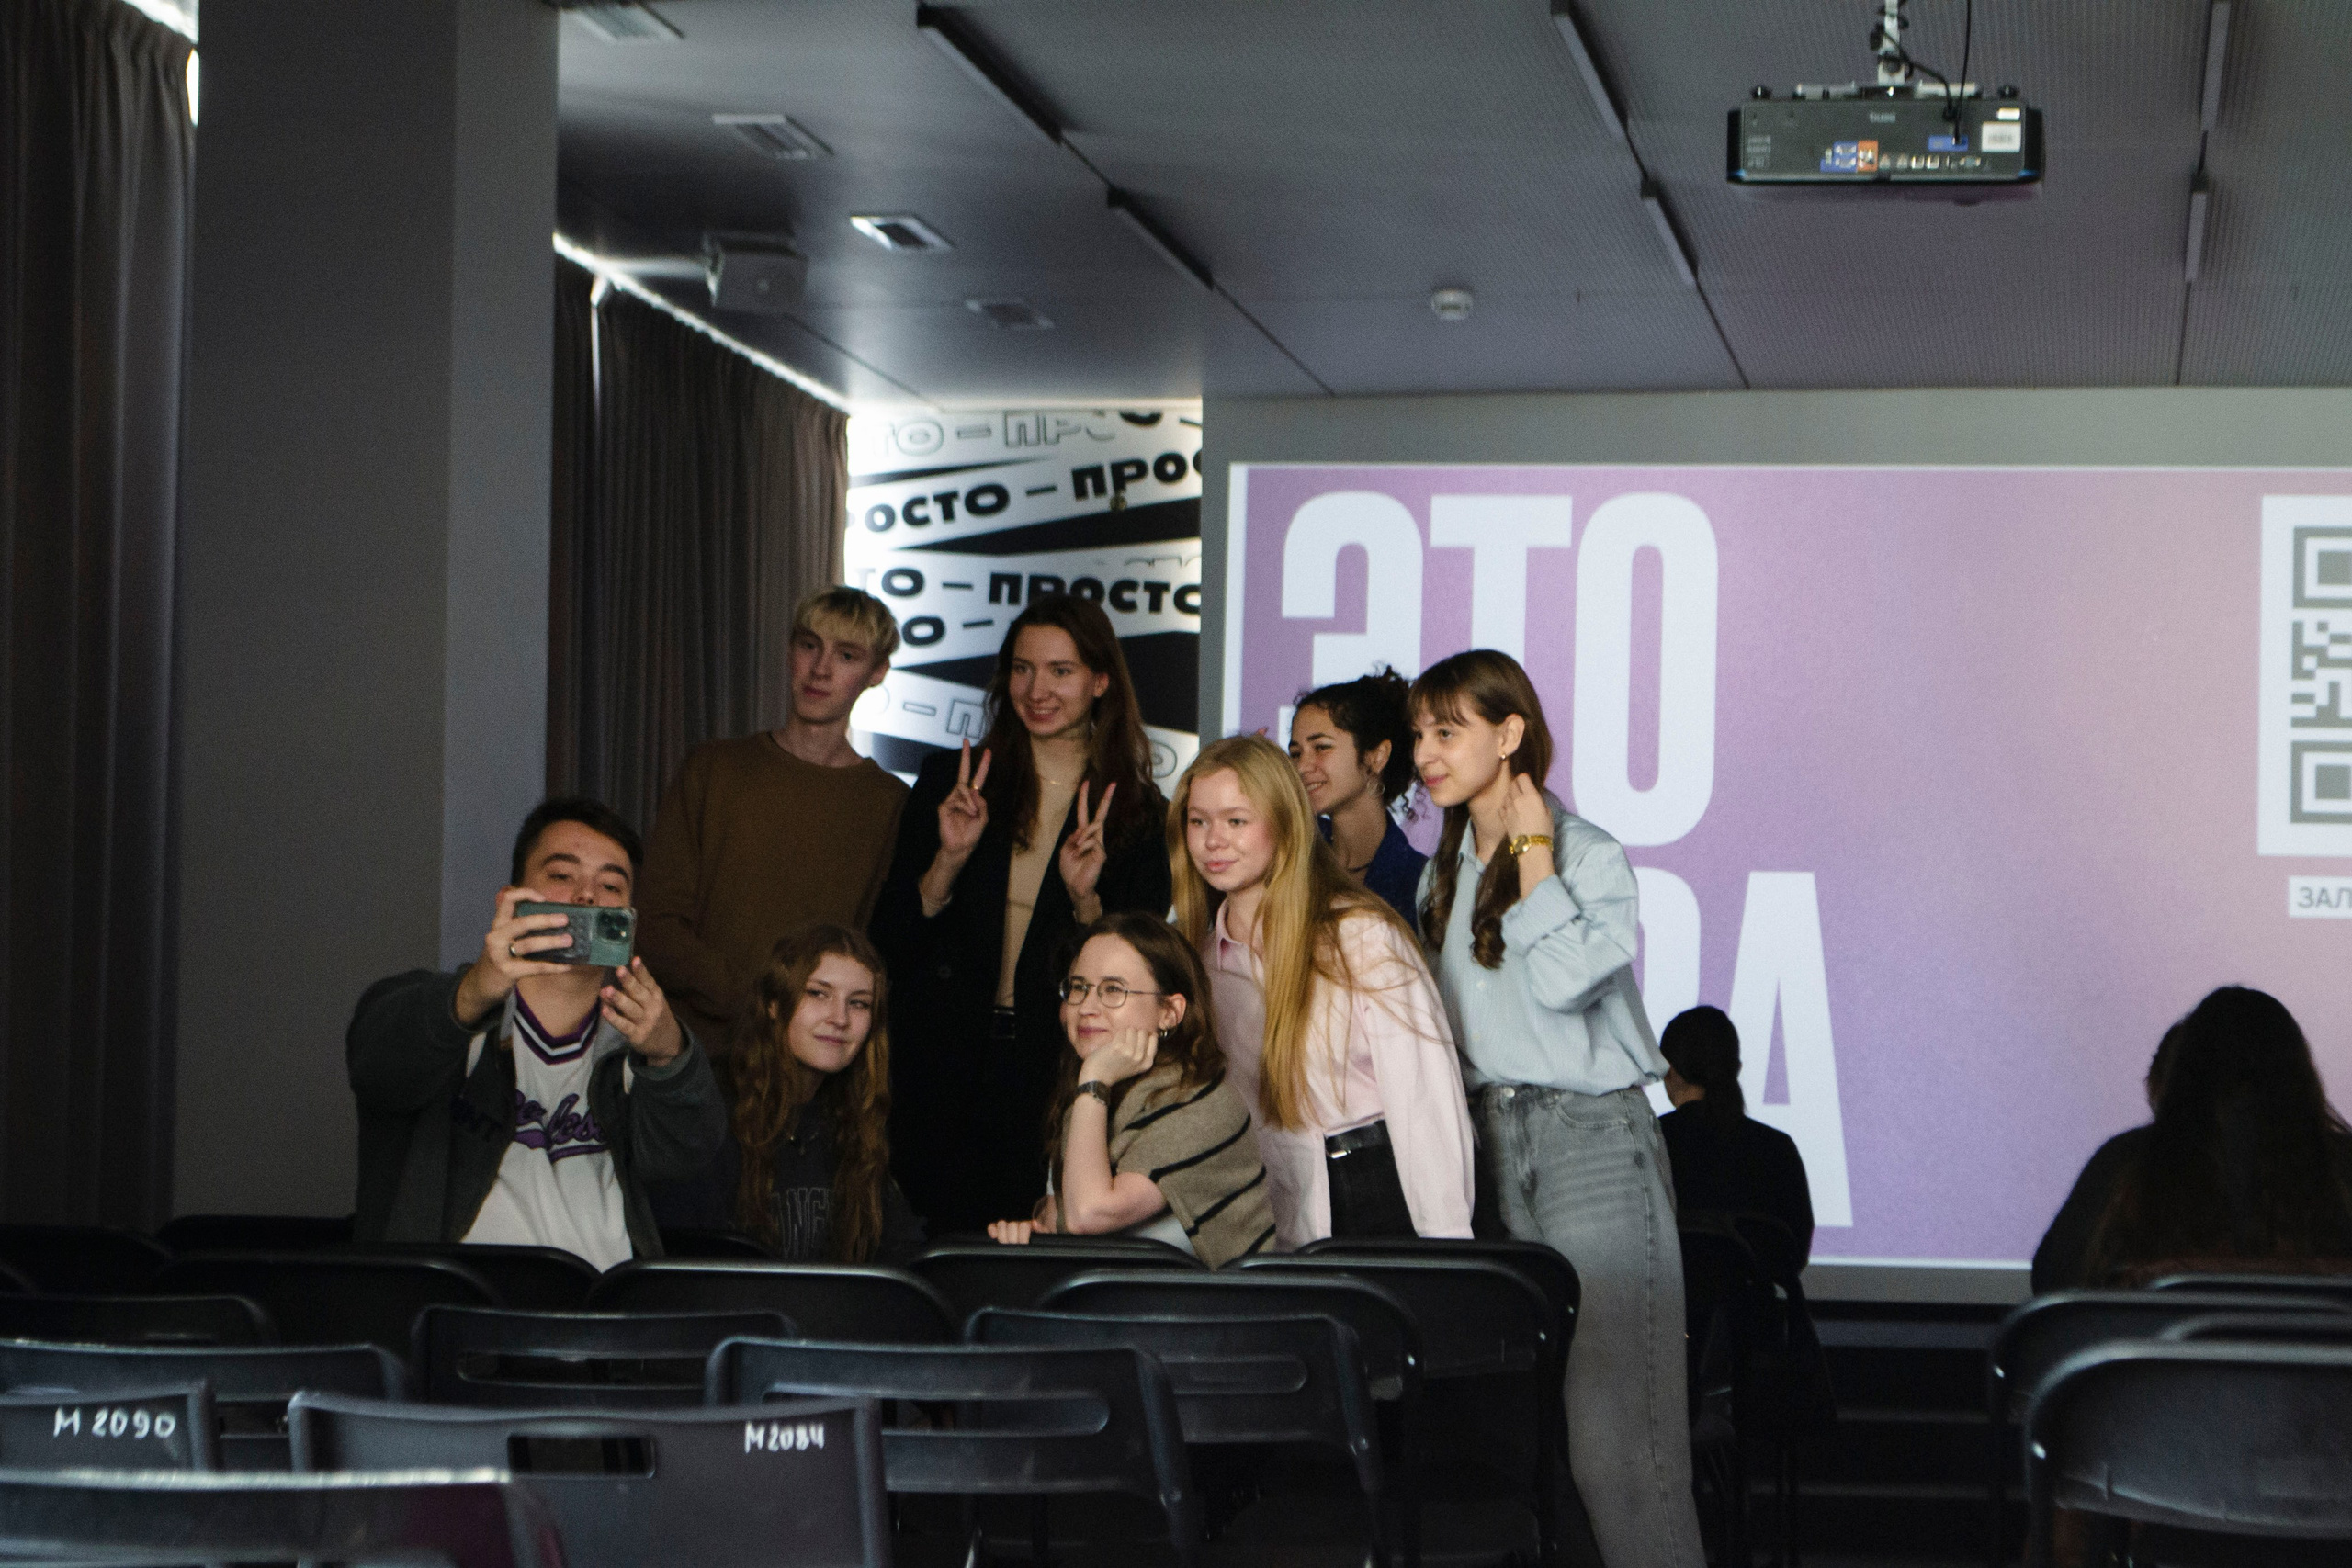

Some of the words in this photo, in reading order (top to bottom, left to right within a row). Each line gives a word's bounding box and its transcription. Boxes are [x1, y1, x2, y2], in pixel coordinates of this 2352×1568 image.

[847, 483, 1010, 533] ОСТО
[1279, 491, 1718, 847] ЭТО
[92, 1406, 176, 1439] 2090
